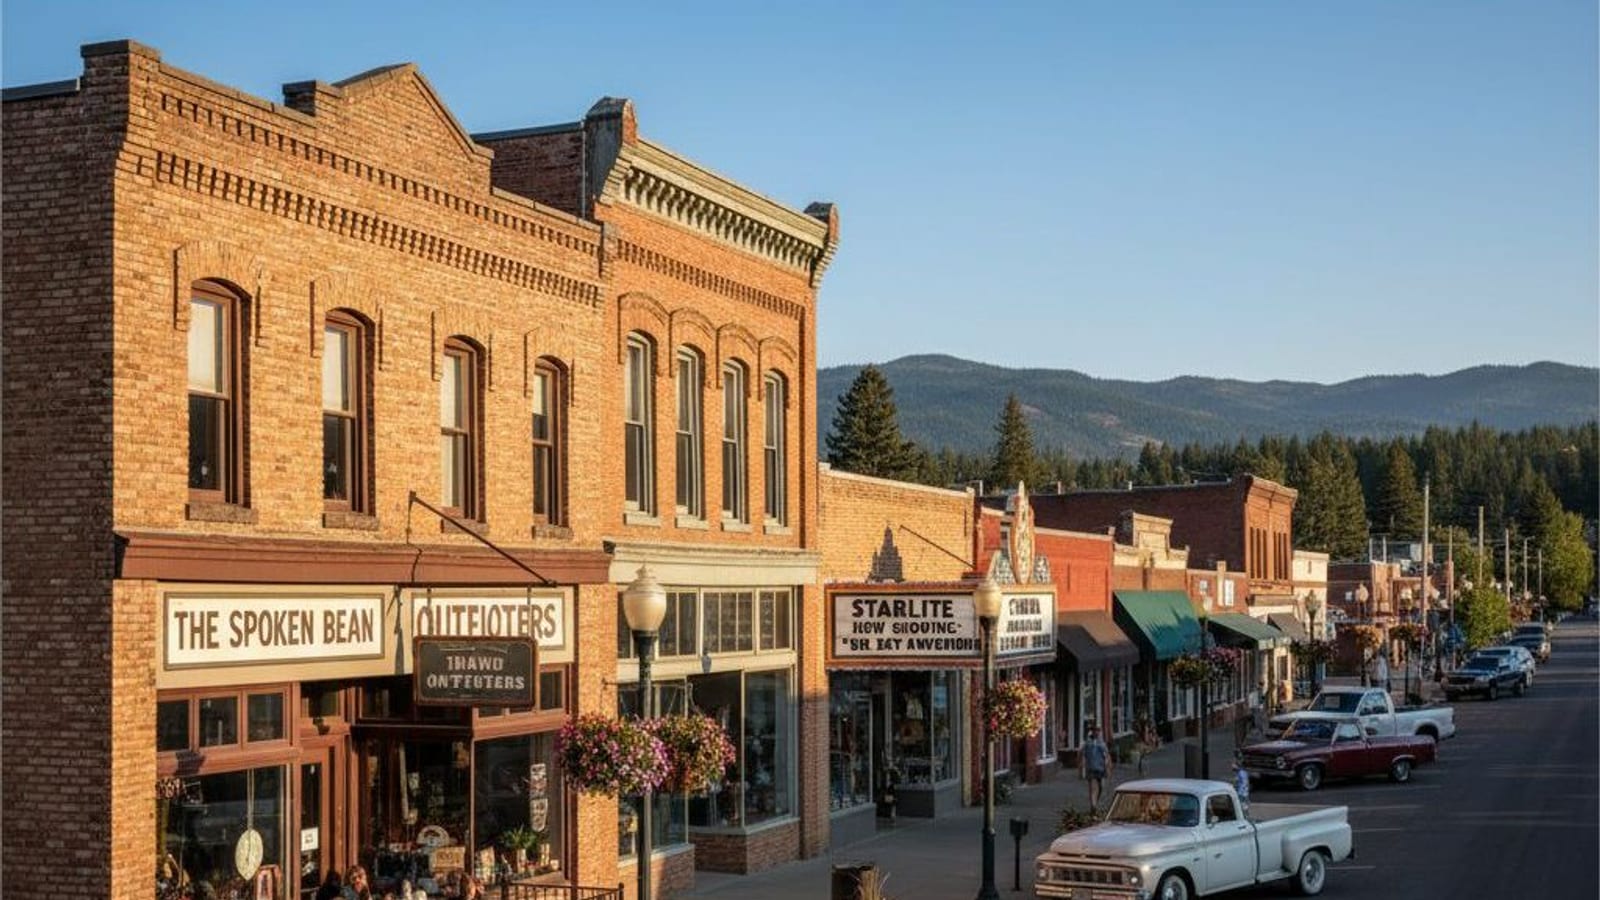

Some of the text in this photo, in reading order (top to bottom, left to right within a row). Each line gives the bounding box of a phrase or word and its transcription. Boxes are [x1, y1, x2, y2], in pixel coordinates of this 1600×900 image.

[852, 598, 953, 618] STARLITE
[173, 607, 374, 650] THE SPOKEN BEAN
